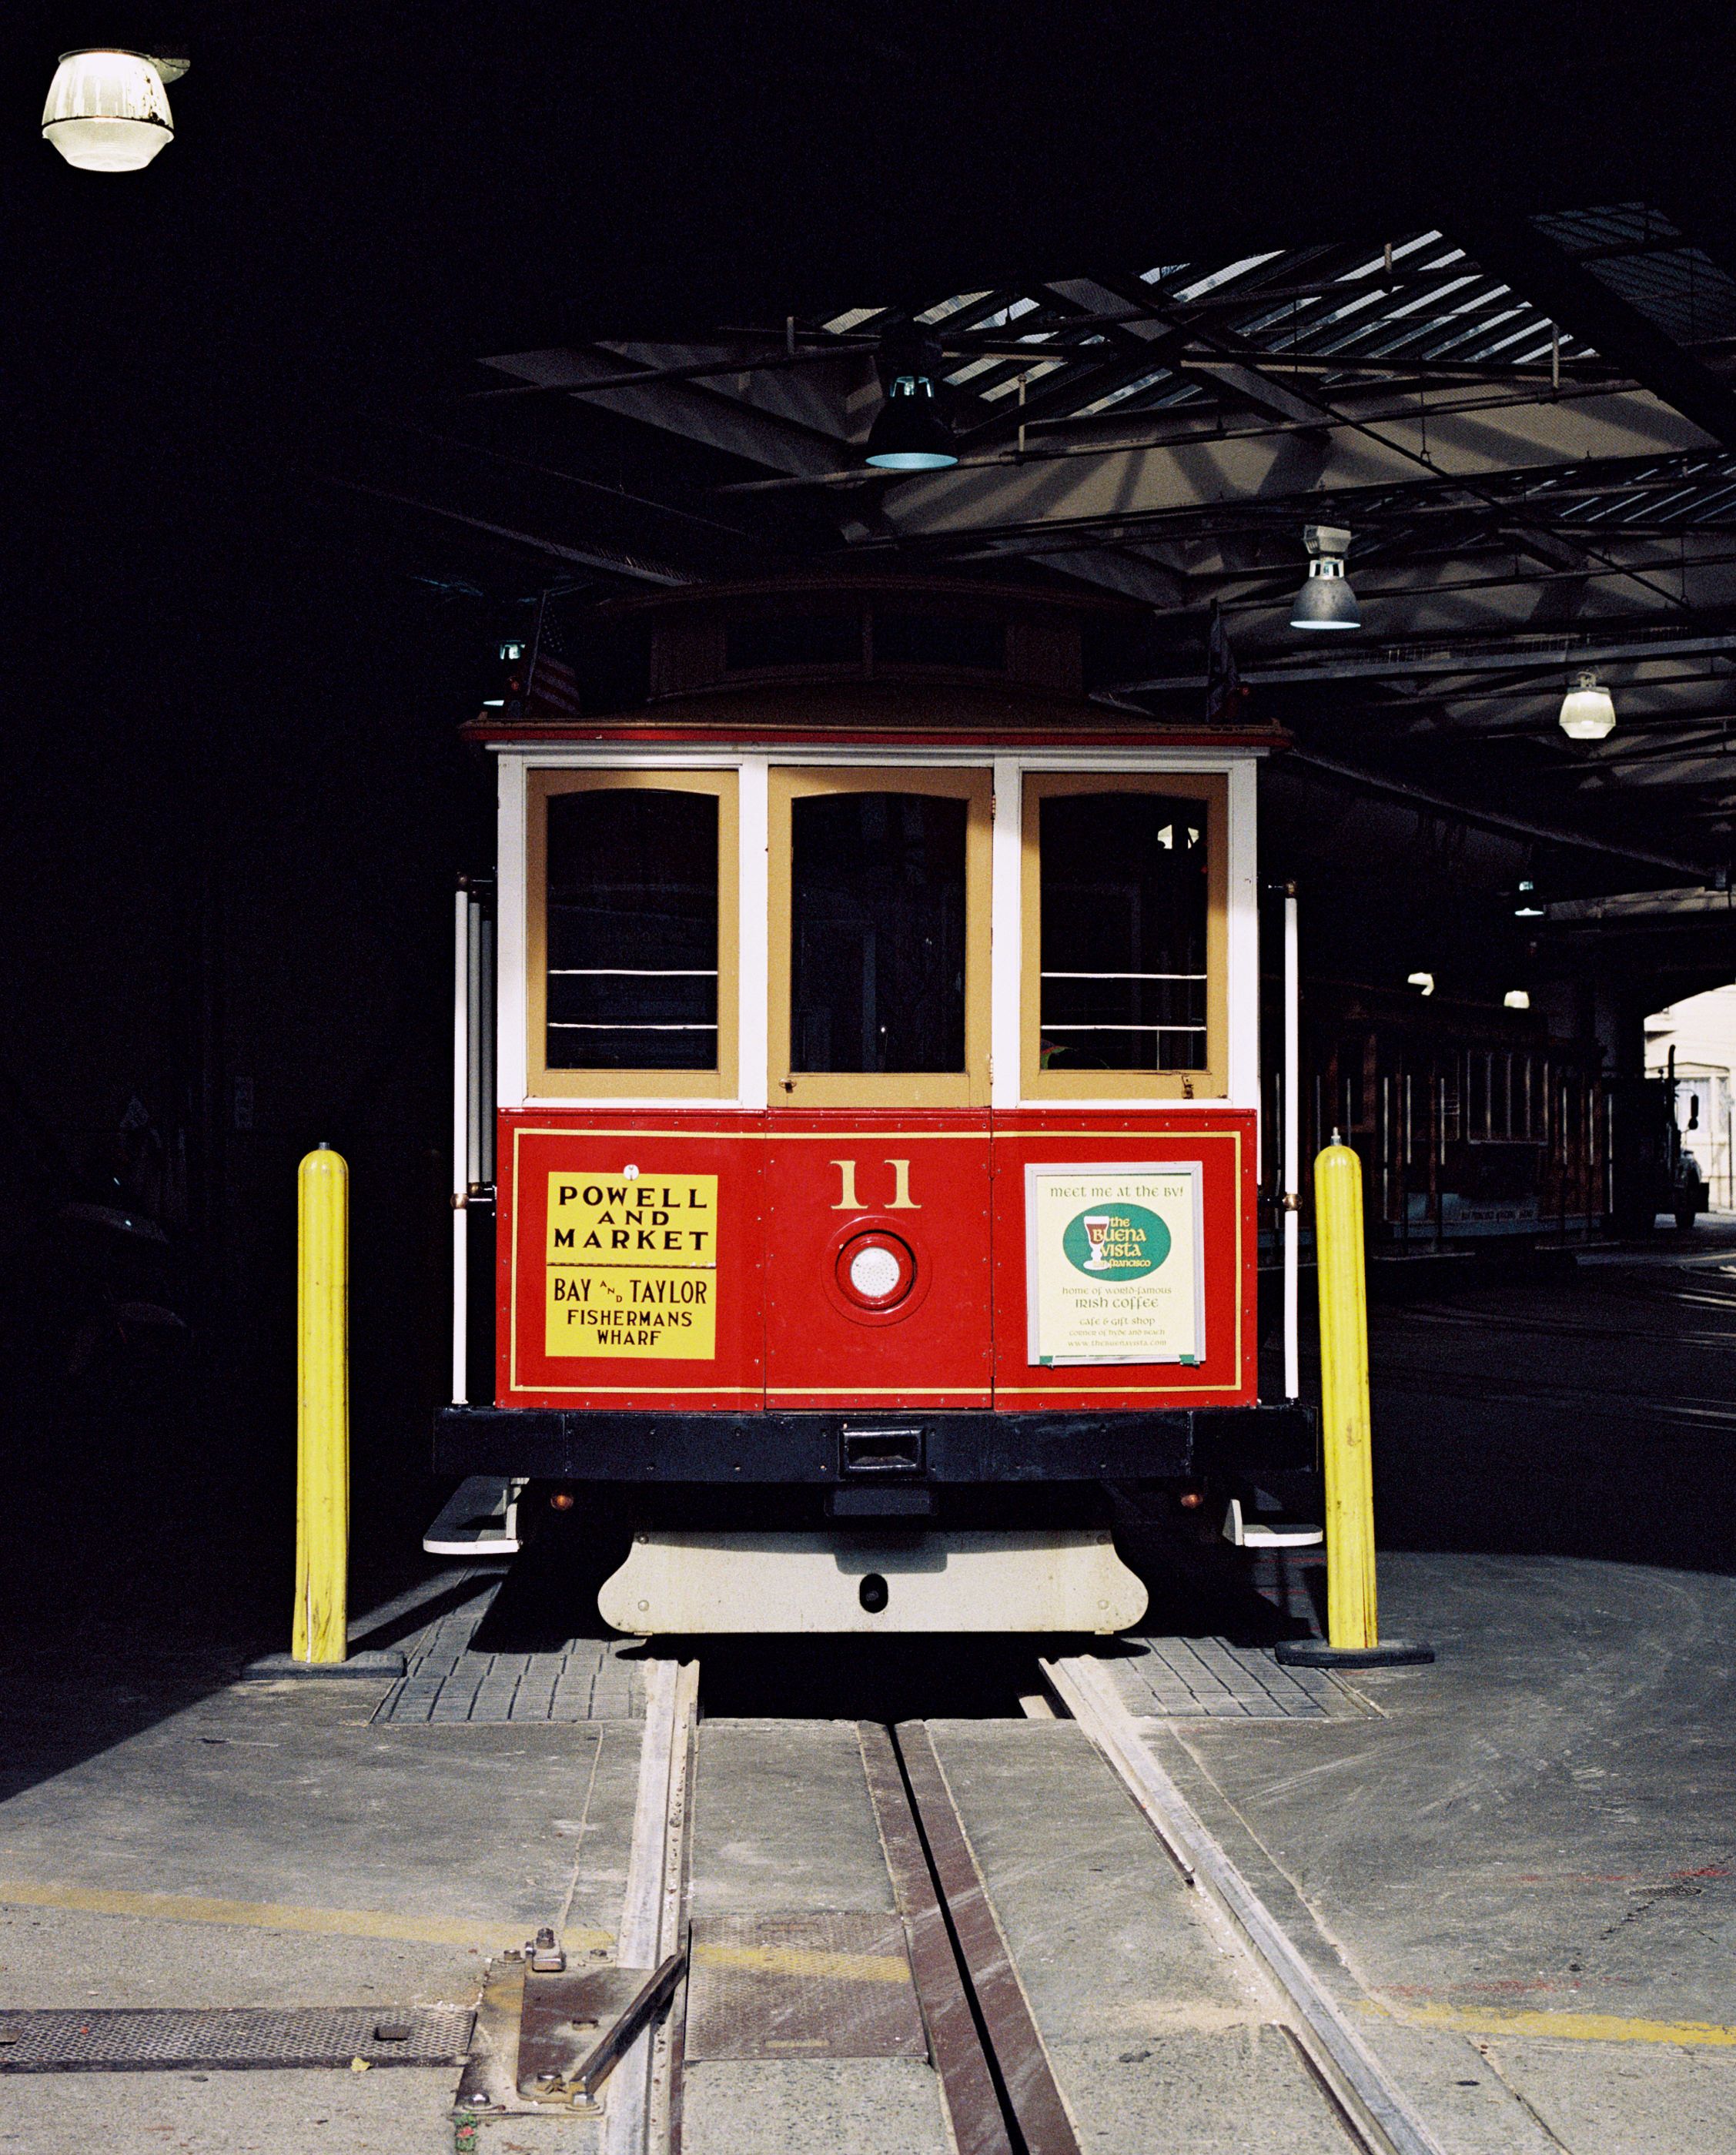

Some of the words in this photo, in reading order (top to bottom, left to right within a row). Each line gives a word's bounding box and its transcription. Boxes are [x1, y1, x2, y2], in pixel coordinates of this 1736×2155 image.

[830, 1159, 922, 1209] 11
[1050, 1186, 1087, 1197] meet
[1092, 1188, 1113, 1197] me
[1117, 1186, 1131, 1197] at
[1136, 1186, 1159, 1197] the
[559, 1186, 707, 1208] POWELL
[597, 1210, 669, 1226] AND
[1110, 1216, 1130, 1227] the
[554, 1229, 708, 1250] MARKET
[1092, 1229, 1147, 1242] Buena
[1100, 1243, 1142, 1257] Vista
[554, 1278, 591, 1301] BAY
[600, 1280, 622, 1303] AND
[630, 1280, 707, 1303] TAYLOR
[1062, 1287, 1089, 1295] home
[1092, 1287, 1102, 1296] of
[1112, 1296, 1159, 1310] coffee
[567, 1309, 692, 1327] FISHERMANS
[1111, 1317, 1129, 1326] gift
[1132, 1317, 1156, 1326] shop
[597, 1329, 661, 1345] WHARF
